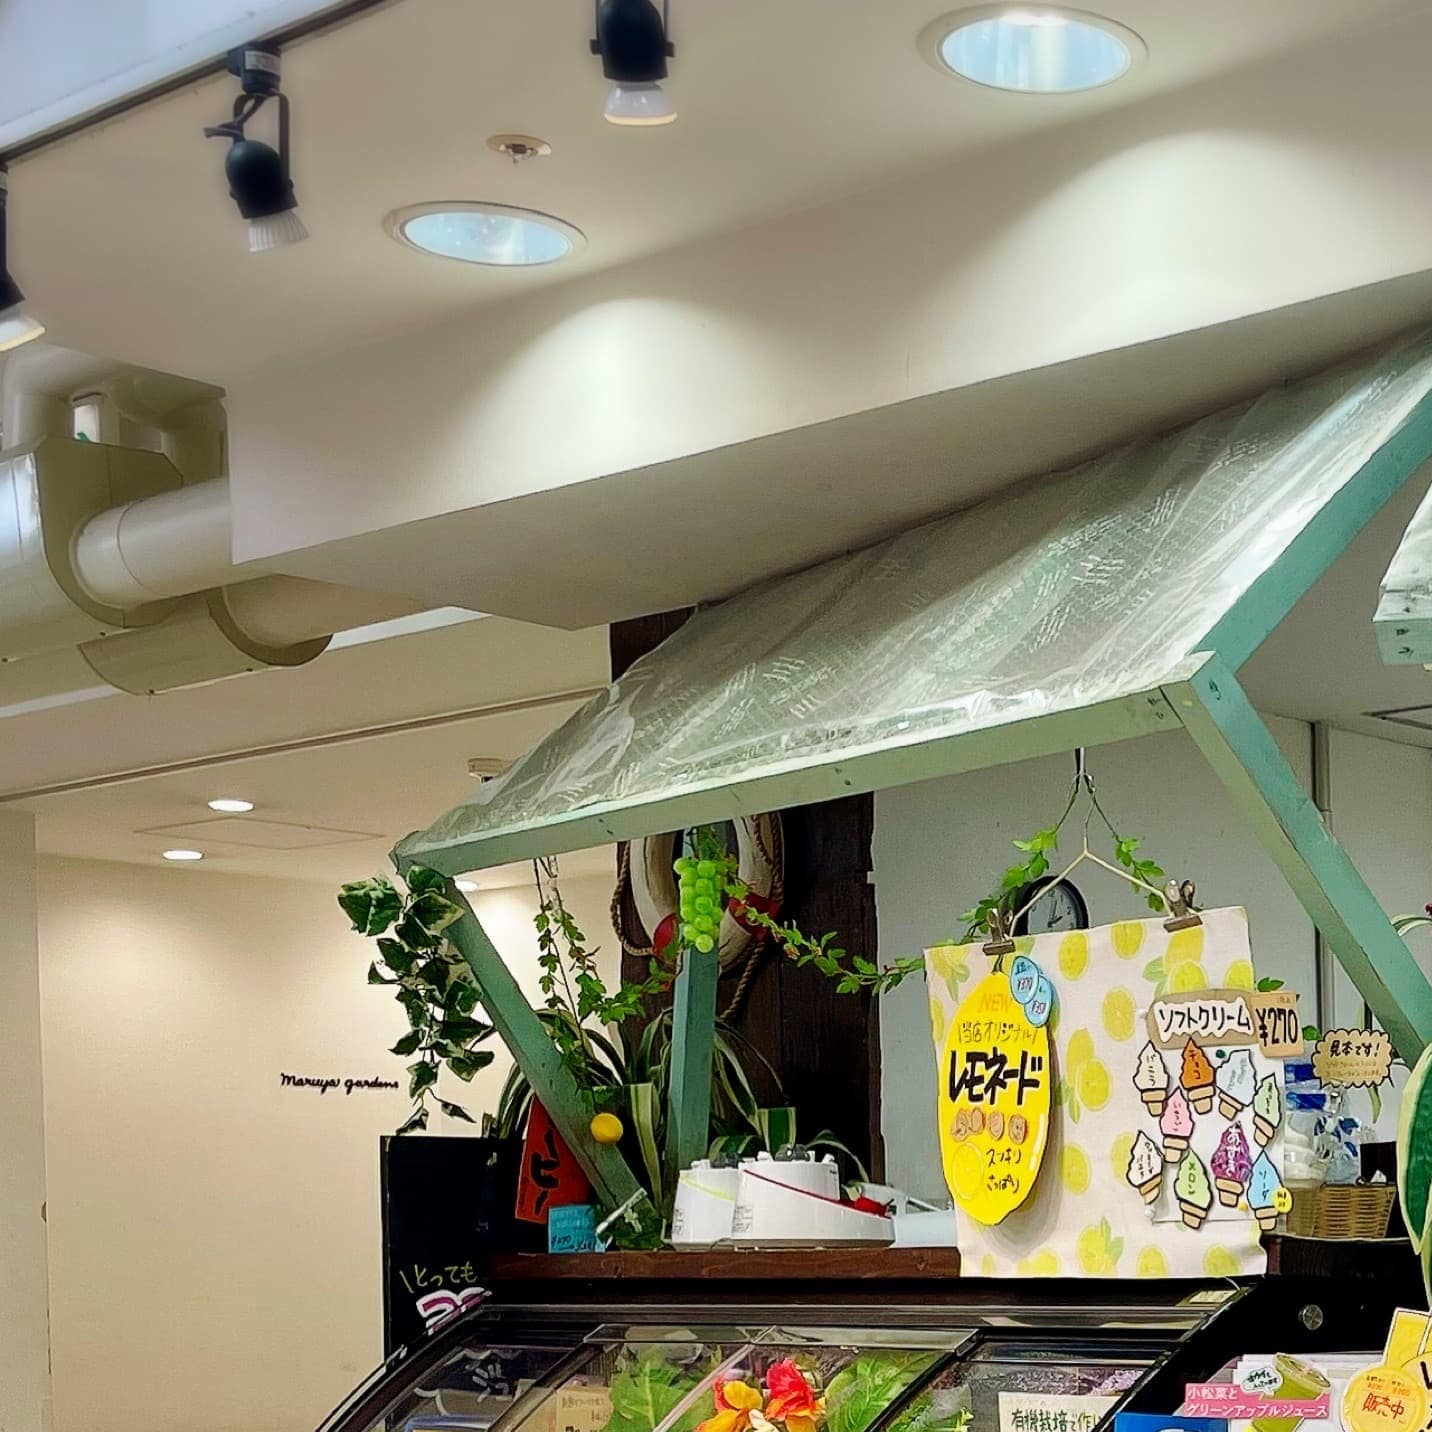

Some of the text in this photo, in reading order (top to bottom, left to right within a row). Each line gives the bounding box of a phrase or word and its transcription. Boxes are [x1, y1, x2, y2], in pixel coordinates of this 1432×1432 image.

[1159, 1004, 1299, 1046] ソフトクリーム ¥270
[280, 1072, 399, 1095] Maruya gardens
[949, 1046, 1043, 1106] レモネード
[1187, 1386, 1238, 1401] 小松菜と
[1186, 1403, 1328, 1417] グリーンアップルジュース
